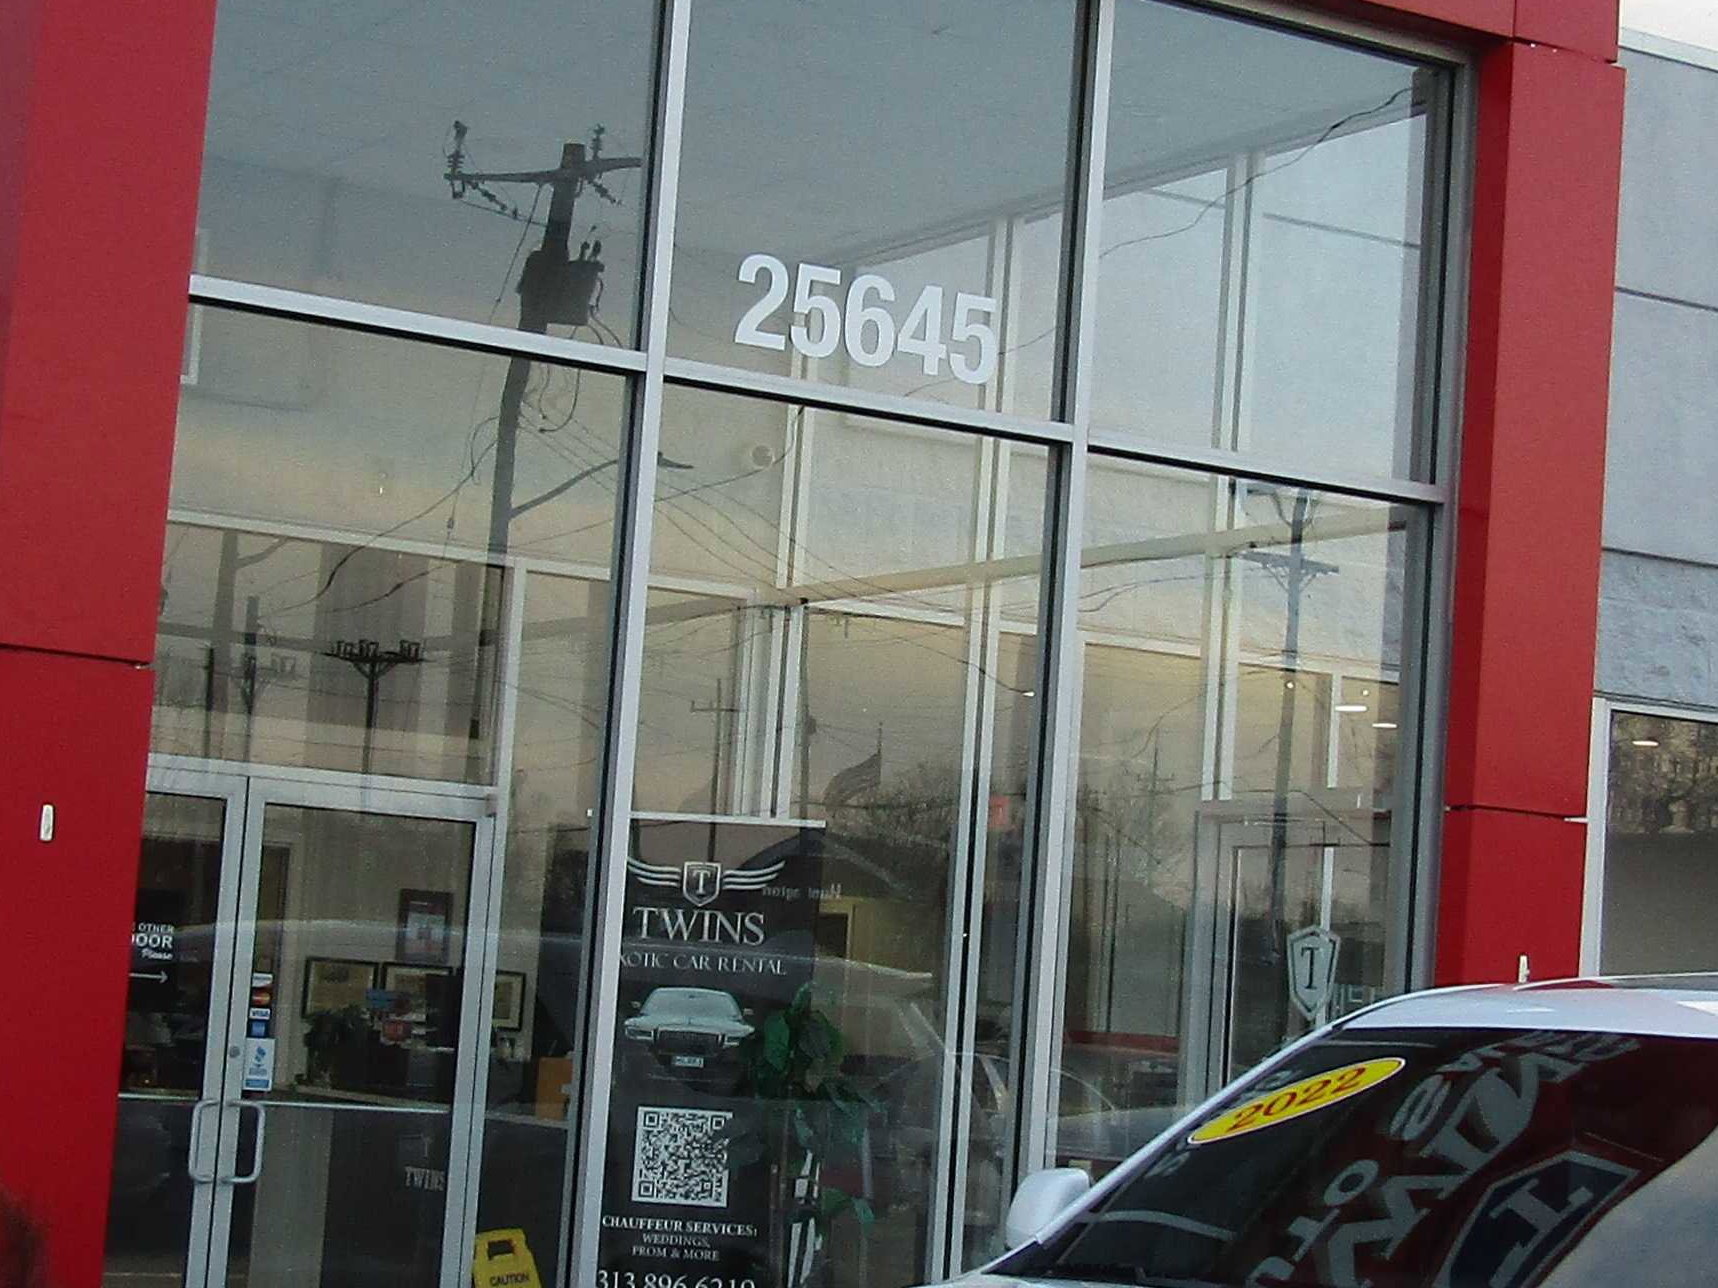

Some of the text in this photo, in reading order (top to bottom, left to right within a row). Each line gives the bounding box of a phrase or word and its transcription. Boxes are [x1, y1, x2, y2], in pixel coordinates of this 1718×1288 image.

[734, 253, 999, 385] 25645
[692, 869, 711, 895] T
[138, 922, 175, 934] OTHER
[633, 906, 765, 946] TWINS
[131, 933, 173, 949] OOR
[673, 953, 710, 971] CAR
[718, 956, 788, 976] RENTAL
[1301, 946, 1320, 990] T
[1226, 1067, 1367, 1133] 2022
[602, 1214, 683, 1233] CHAUFFEUR
[683, 1249, 721, 1262] MORE
[489, 1272, 531, 1287] CAUTION
